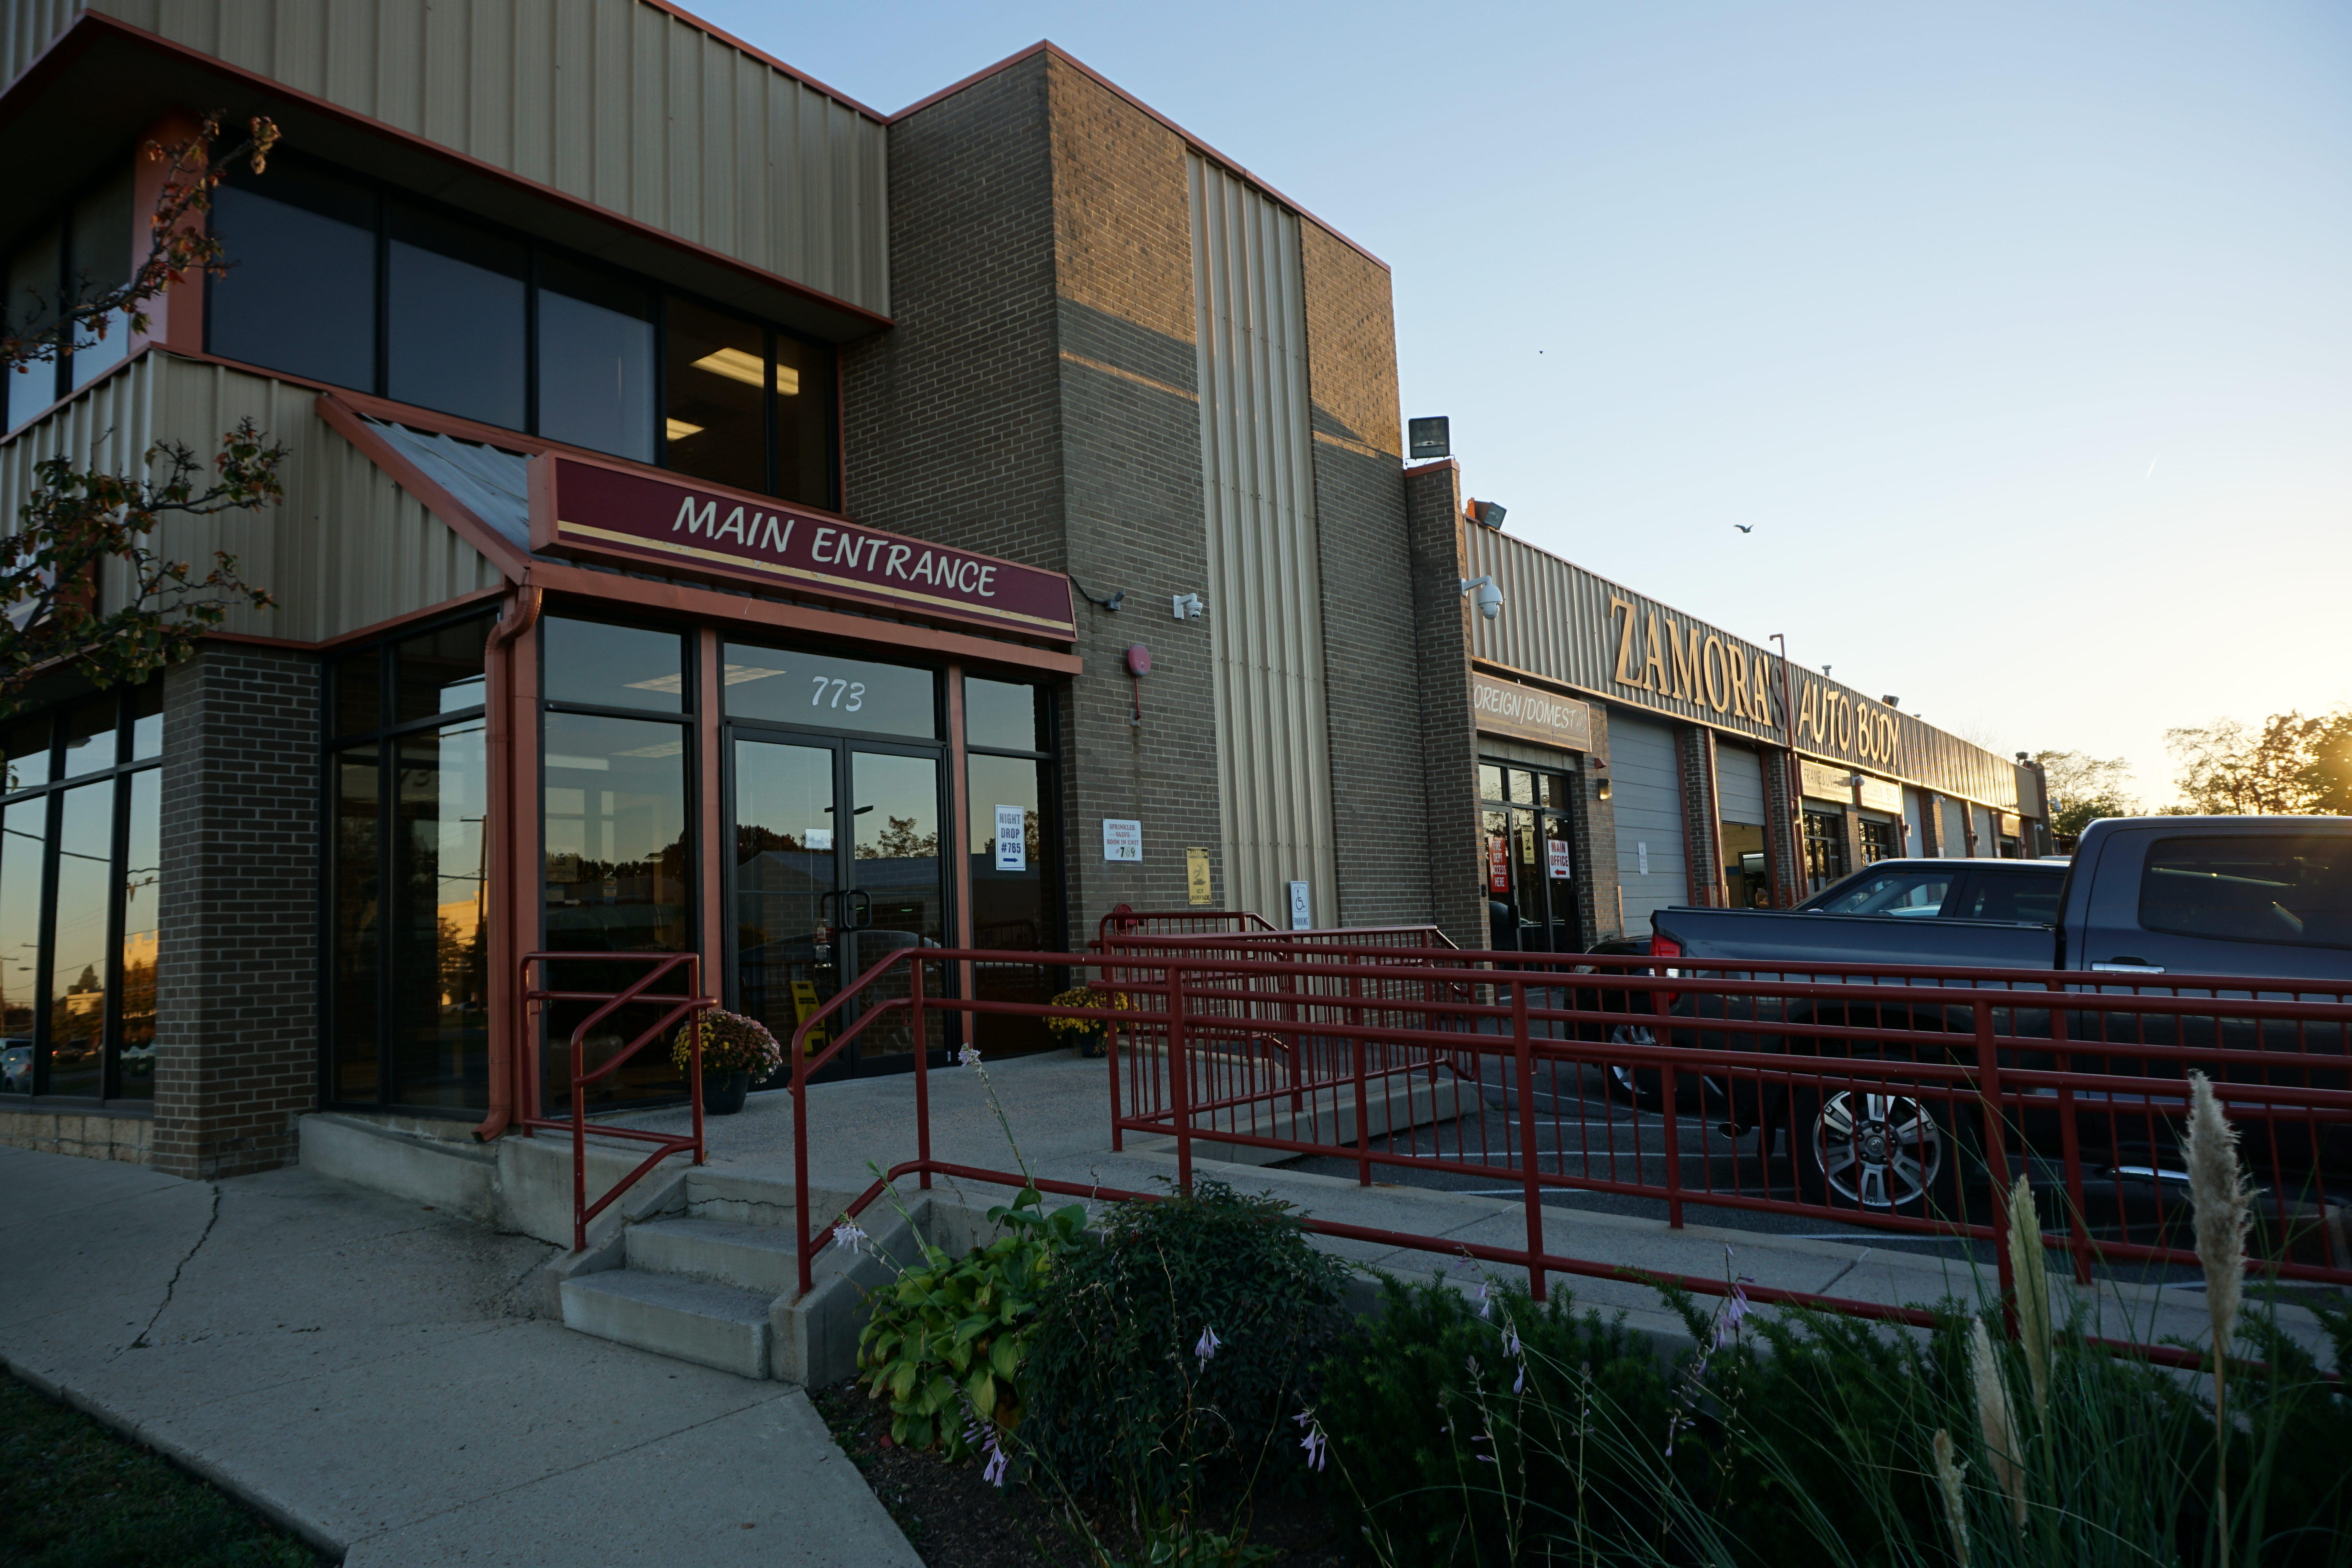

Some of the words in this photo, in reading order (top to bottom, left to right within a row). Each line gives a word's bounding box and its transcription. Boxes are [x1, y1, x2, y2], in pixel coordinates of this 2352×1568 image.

[672, 496, 795, 553] MAIN
[812, 528, 997, 596] ENTRANCE
[1611, 593, 1787, 731] ZAMORA'S
[1798, 679, 1850, 751] AUTO
[1857, 702, 1899, 766] BODY
[812, 676, 865, 711] 773
[1473, 683, 1587, 732] OREIGN/DOMESTIC
[1804, 768, 1821, 785] FRAME
[999, 813, 1020, 824] NIGHT
[1001, 828, 1020, 838] DROP
[1001, 842, 1021, 853] #765
[1493, 841, 1501, 851] FIRE
[1551, 842, 1565, 853] MAIN
[1493, 853, 1502, 862] DEPT
[1550, 855, 1568, 866] OFFICE
[1492, 865, 1506, 875] ACCESS
[1495, 877, 1505, 887] HERE
[1294, 917, 1308, 926] PARKING
